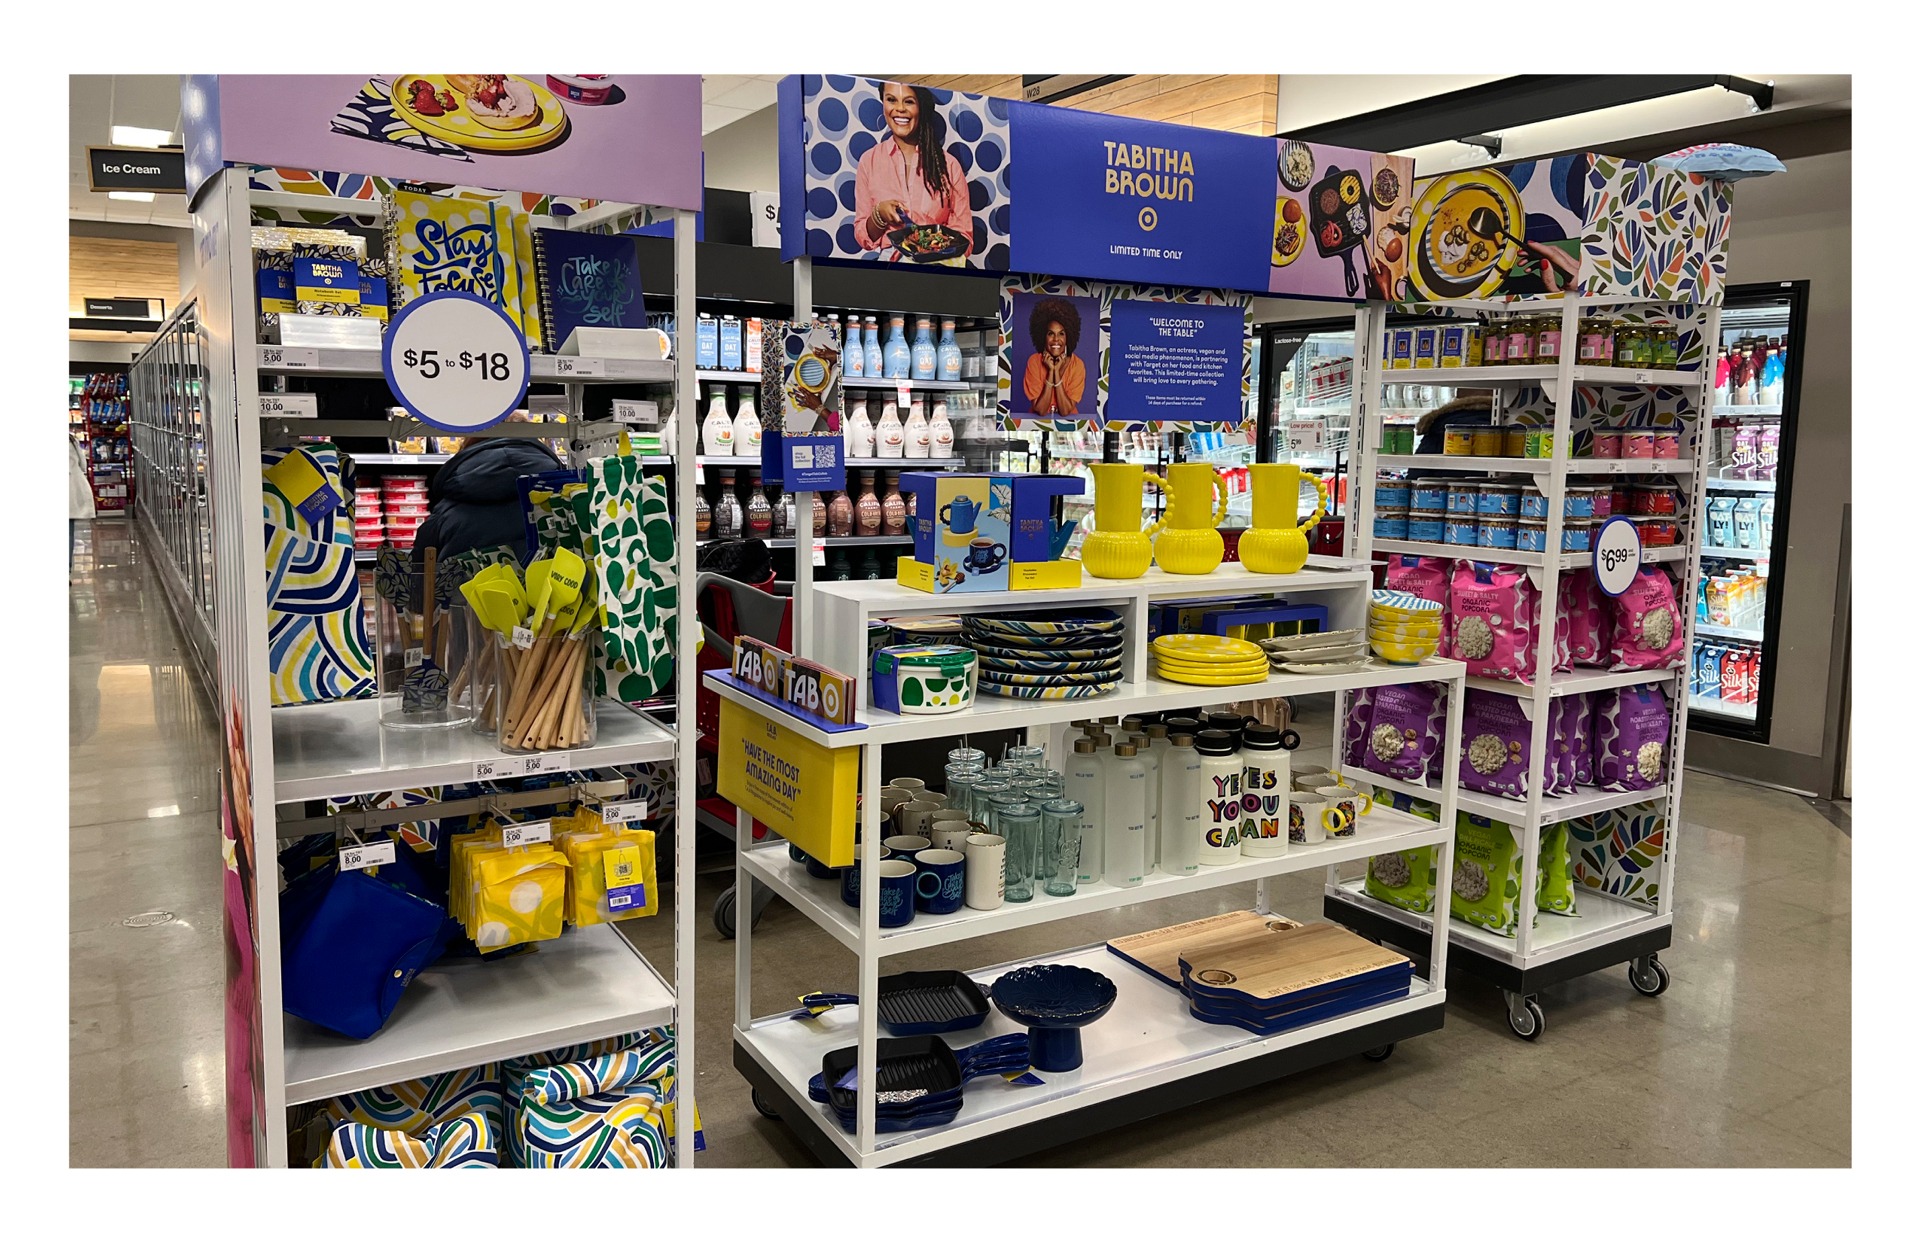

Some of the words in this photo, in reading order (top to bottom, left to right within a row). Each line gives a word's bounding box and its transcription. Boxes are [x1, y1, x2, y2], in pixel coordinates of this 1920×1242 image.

[1026, 86, 1040, 99] W28
[1104, 140, 1194, 176] TABITHA
[102, 164, 120, 174] Ice
[122, 164, 161, 174] Cream
[404, 185, 426, 193] TODAY
[1105, 168, 1194, 202] BROWN
[412, 218, 493, 267] Stay
[1110, 245, 1140, 256] LIMITED
[1142, 248, 1160, 258] TIME
[1164, 250, 1182, 260] ONLY
[312, 264, 342, 272] TABITHA
[568, 254, 610, 276] Take
[312, 270, 343, 278] BROWN
[1194, 320, 1204, 329] TO
[1158, 328, 1171, 336] THE
[702, 342, 712, 350] OAT
[264, 354, 282, 362] 5.00
[404, 348, 440, 379] $5
[445, 359, 455, 367] to
[460, 350, 510, 381] $18
[1732, 447, 1756, 468] Silk
[1714, 521, 1728, 529] LY!
[1739, 522, 1754, 530] LY!
[1392, 585, 1424, 593] ORGANIC
[1462, 598, 1490, 606] ORGANIC
[1710, 595, 1726, 604] Silk
[1462, 605, 1490, 613] POPCORN
[1699, 669, 1720, 684] Silk
[1721, 674, 1742, 688] Silk
[1384, 690, 1406, 698] VEGAN
[1379, 702, 1412, 713] PARMESAN
[1472, 704, 1499, 714] ROASTED
[1488, 700, 1513, 710] VEGAN
[1481, 712, 1519, 725] PARMESAN
[526, 762, 540, 770] 5.00
[762, 750, 775, 770] THE
[776, 758, 799, 783] MOST
[746, 760, 780, 793] AMAZING
[1242, 766, 1277, 789] ES
[1212, 774, 1241, 798] YE
[1241, 793, 1279, 816] OU
[1207, 799, 1241, 822] YO
[1241, 818, 1279, 839] AN
[506, 834, 520, 842] 5.00
[1206, 822, 1241, 847] CA
[1460, 841, 1492, 854] ORGANIC
[345, 855, 361, 864] 8.00
[1458, 848, 1490, 860] POPCORN
